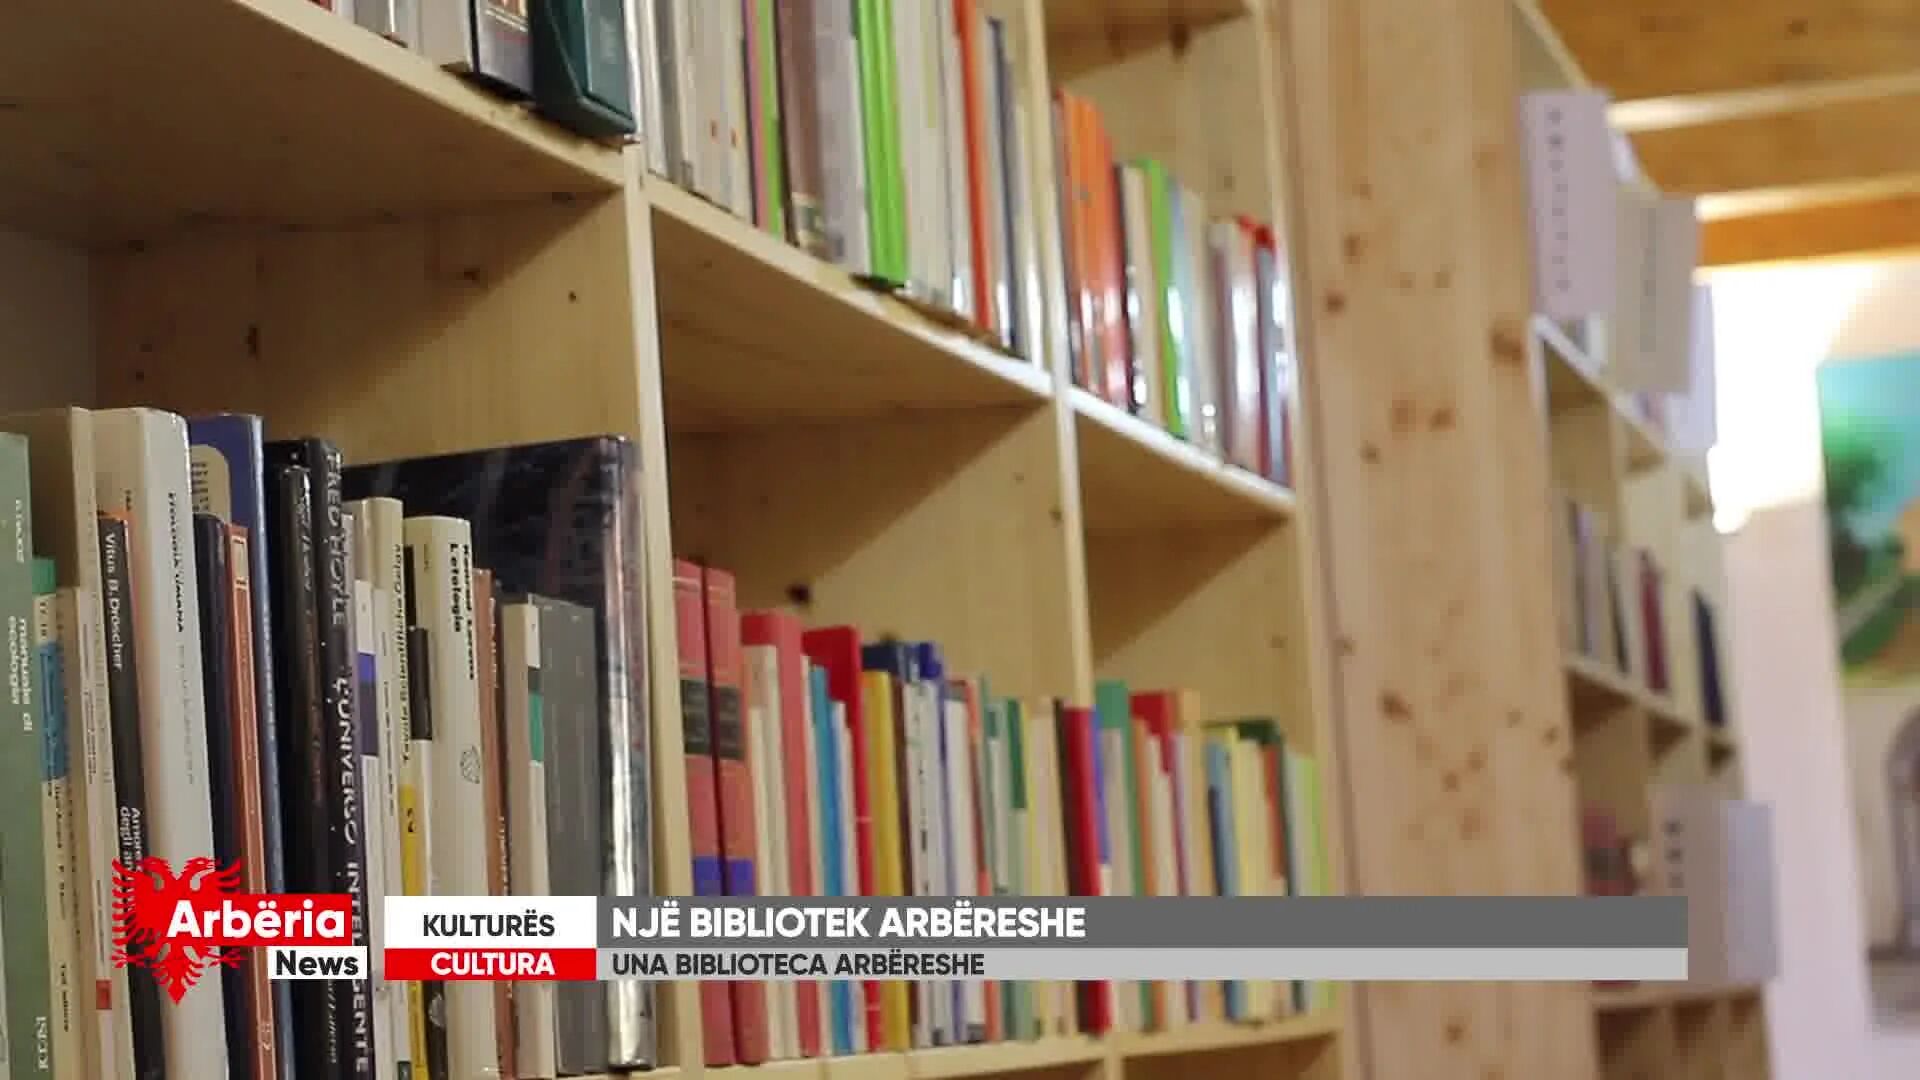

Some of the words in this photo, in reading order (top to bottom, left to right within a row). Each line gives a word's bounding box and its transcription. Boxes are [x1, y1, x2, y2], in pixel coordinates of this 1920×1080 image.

[105, 532, 116, 574] Vitus
[8, 615, 20, 704] ecologia
[18, 618, 33, 704] manuale
[22, 712, 33, 731] di
[120, 805, 133, 846] degli
